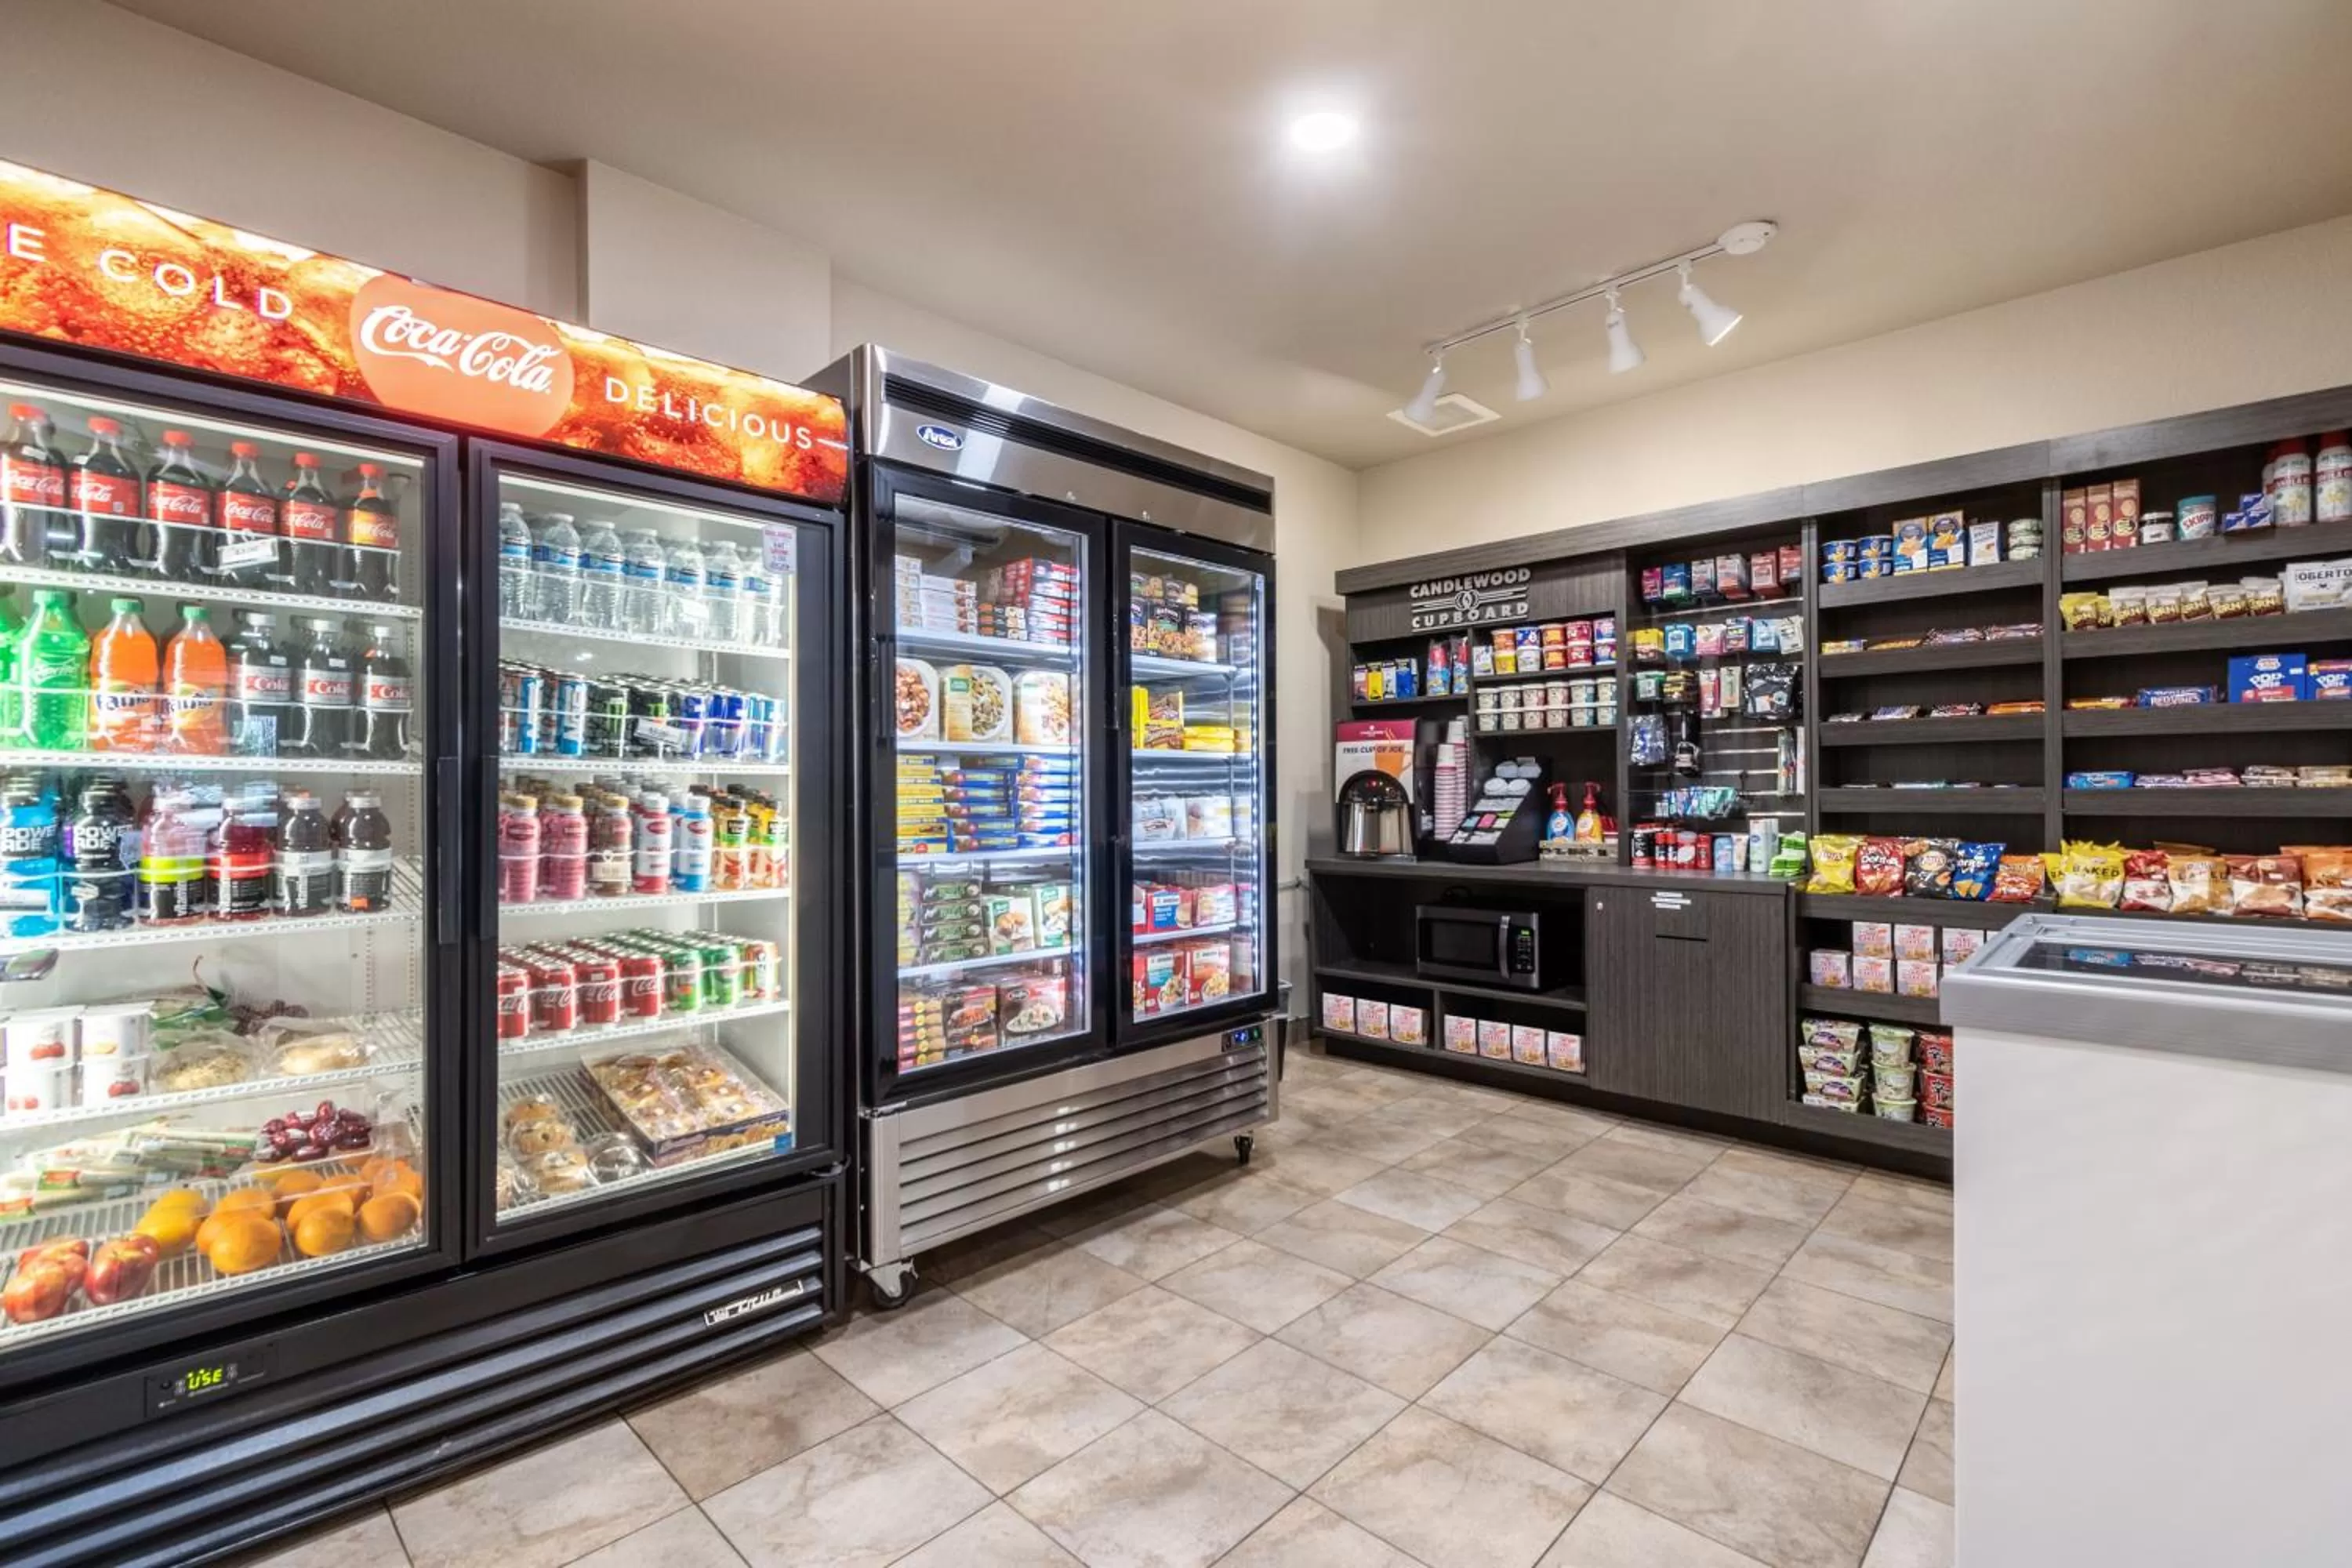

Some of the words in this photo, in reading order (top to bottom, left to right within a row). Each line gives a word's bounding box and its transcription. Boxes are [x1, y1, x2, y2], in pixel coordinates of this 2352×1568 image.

[99, 248, 294, 321] COLD
[360, 304, 562, 394] Coca-Cola
[604, 376, 814, 450] DELICIOUS
[2182, 512, 2215, 530] SKIPPY
[1410, 568, 1531, 598] CANDLEWOOD
[2298, 568, 2352, 581] OBERTO
[1412, 602, 1529, 629] CUPBOARD
[1, 825, 56, 840] POWE
[2073, 864, 2121, 877] BAKED
